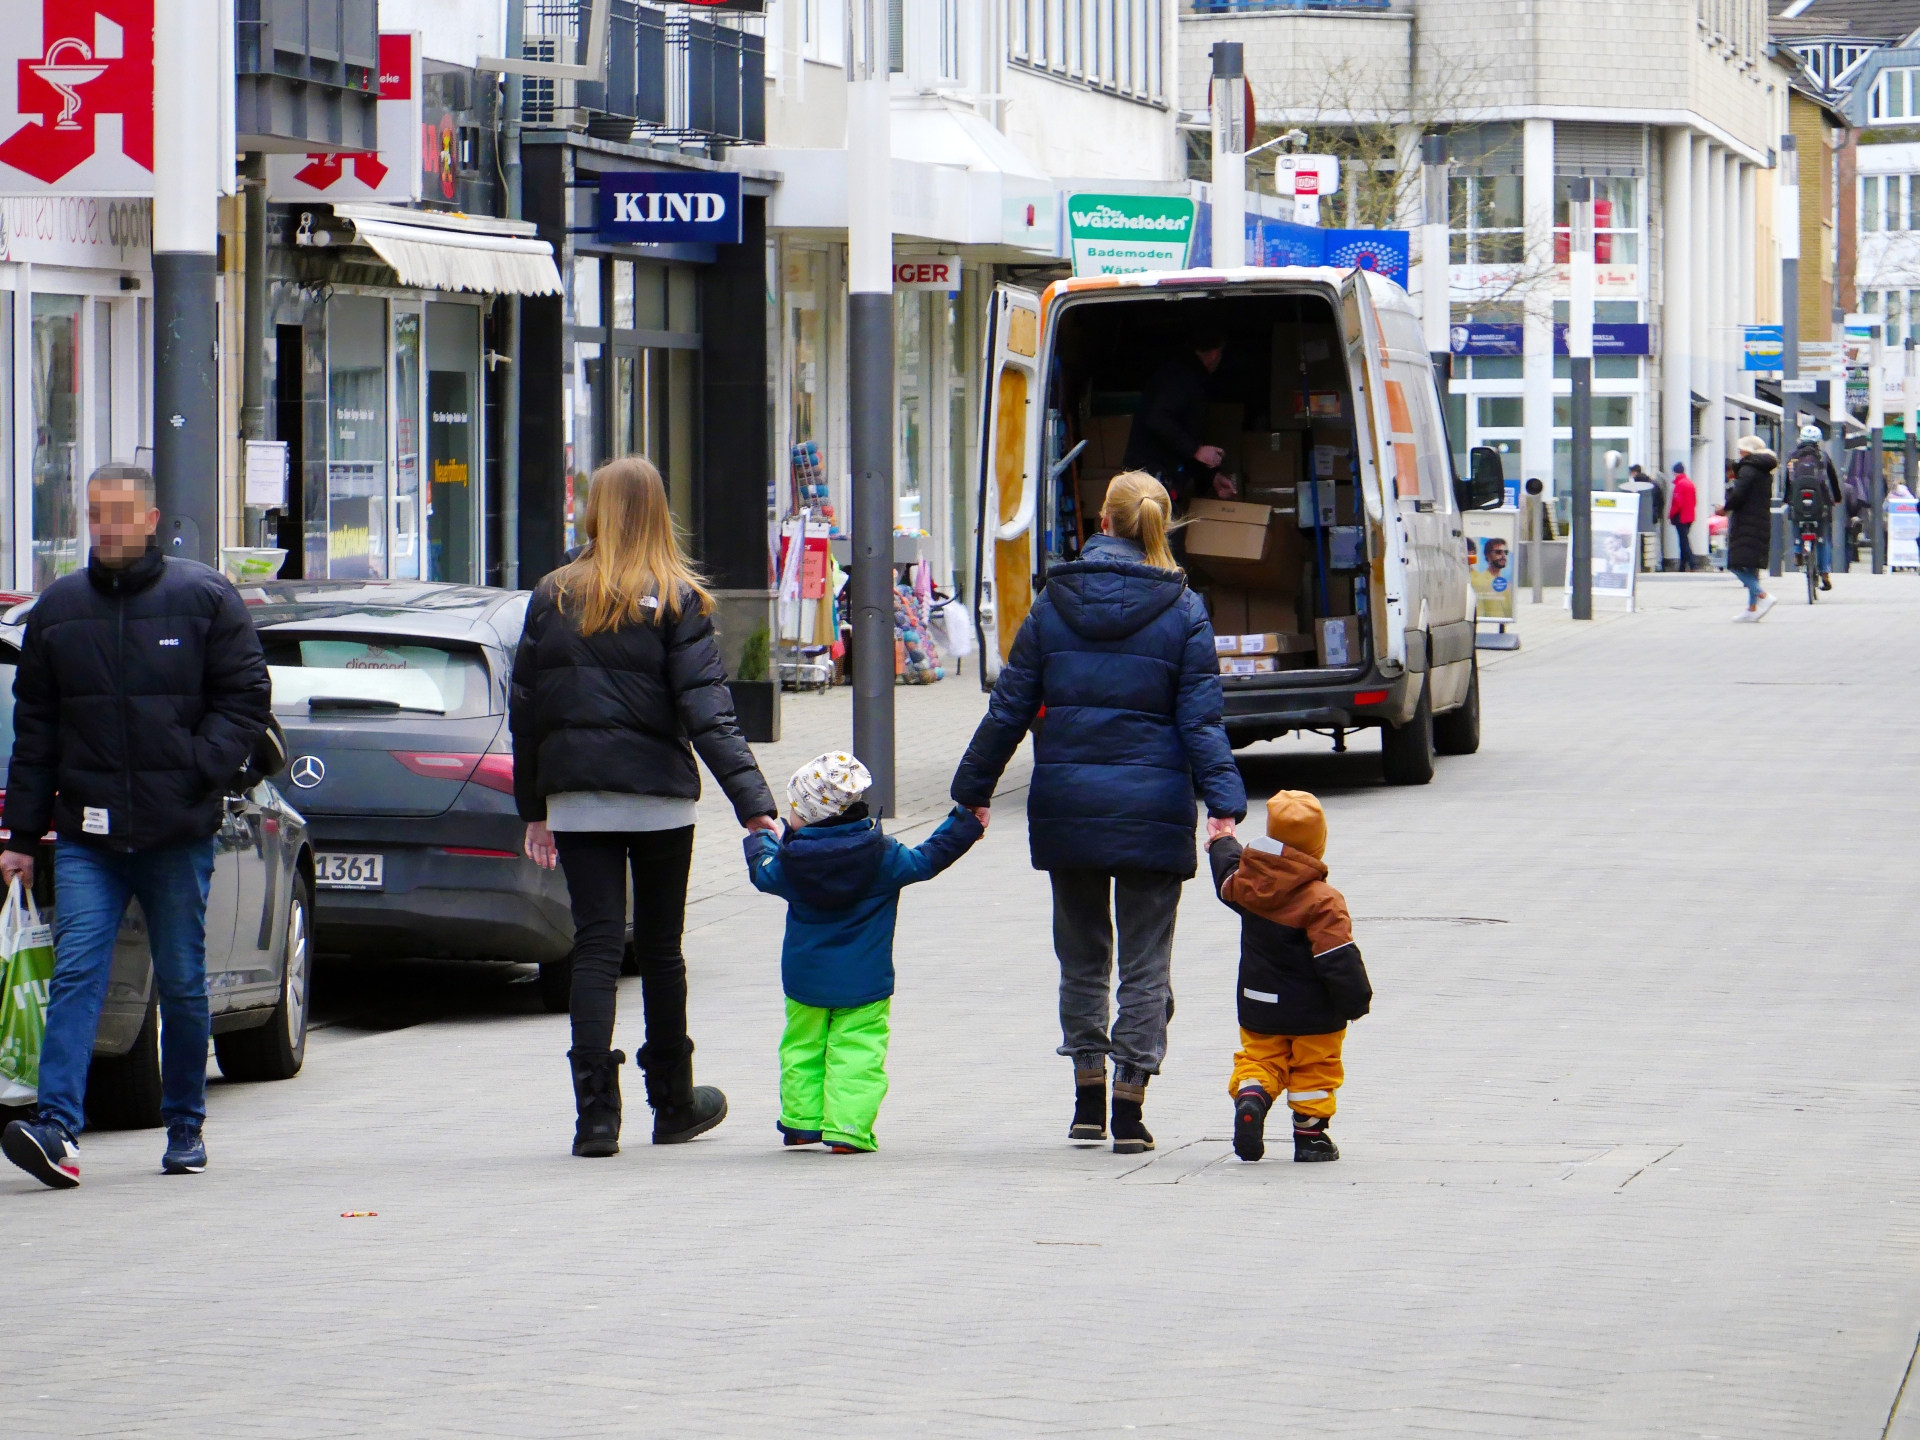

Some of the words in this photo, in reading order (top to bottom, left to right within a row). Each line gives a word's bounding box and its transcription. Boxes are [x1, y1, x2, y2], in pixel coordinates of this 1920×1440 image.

[379, 73, 400, 83] eke
[613, 192, 726, 223] KIND
[1087, 246, 1173, 259] Bademoden
[315, 856, 378, 881] 1361
